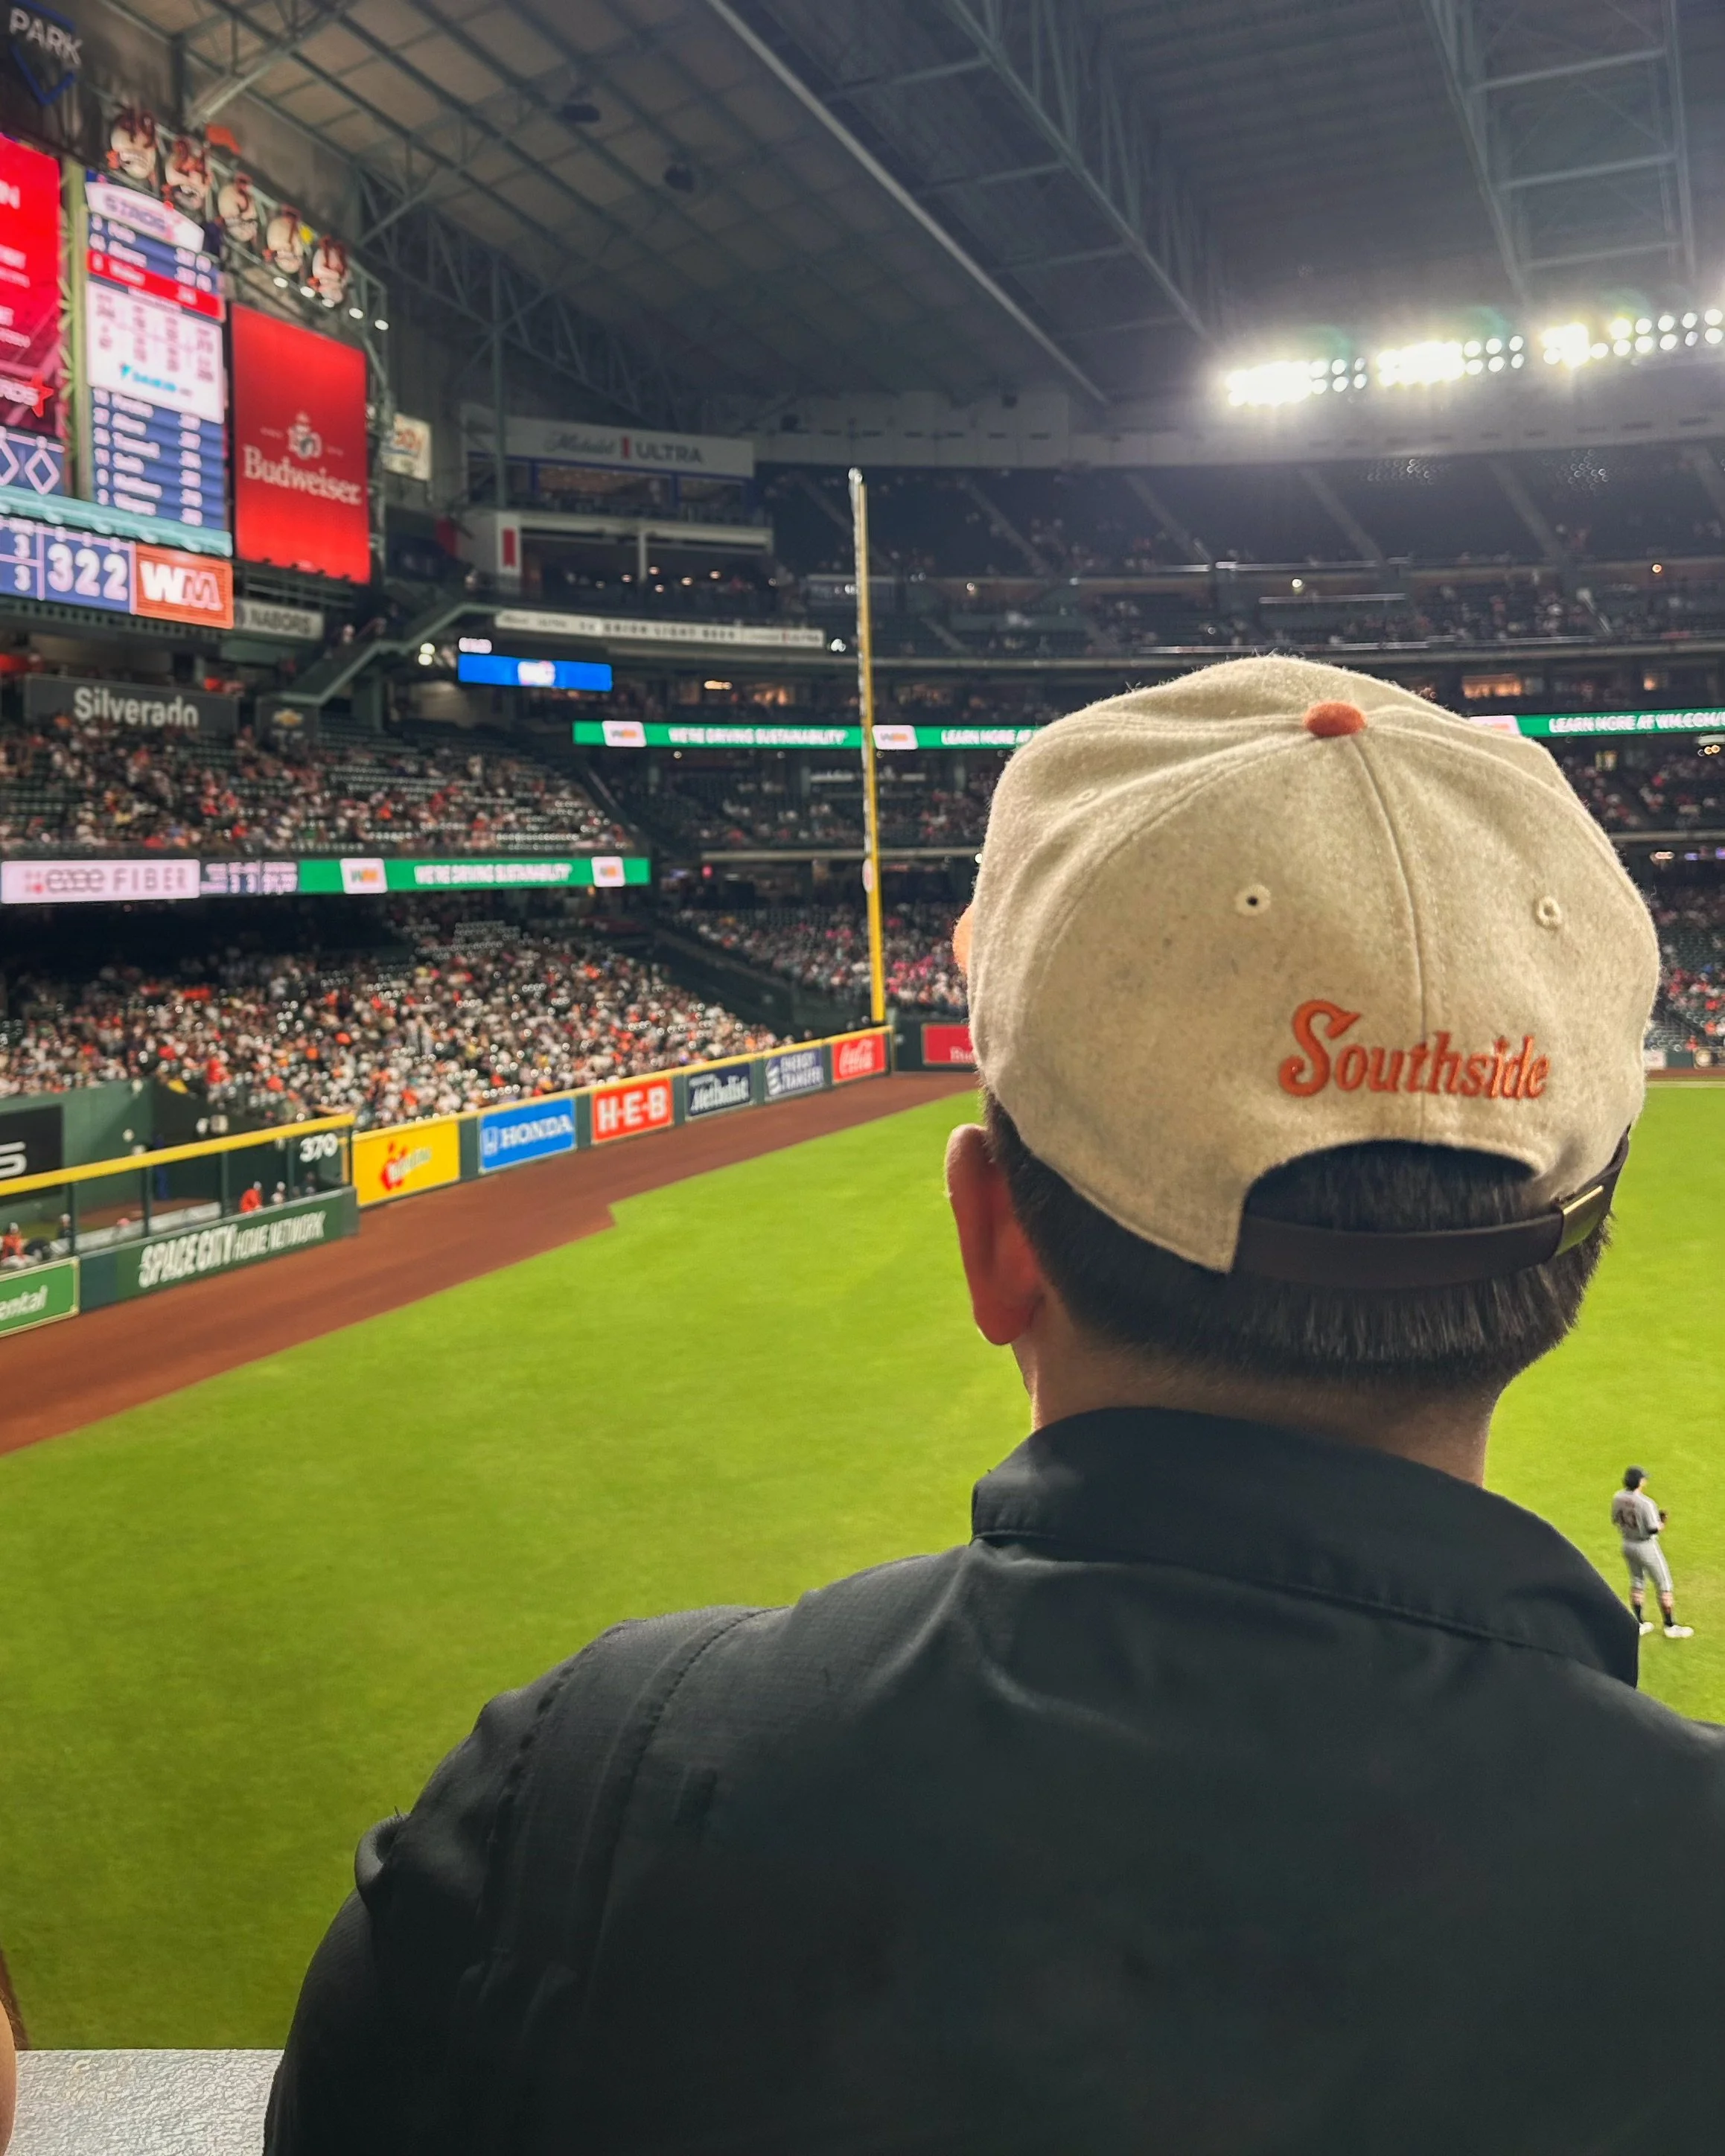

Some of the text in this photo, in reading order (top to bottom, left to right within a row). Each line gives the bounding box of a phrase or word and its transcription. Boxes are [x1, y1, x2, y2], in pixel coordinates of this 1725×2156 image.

[9, 7, 83, 65] PARK
[637, 442, 702, 462] ULTRA
[243, 444, 363, 505] Budweiser
[74, 686, 200, 728] Silverado
[940, 729, 980, 745] LEARN
[1549, 716, 1596, 733] LEARN
[1595, 715, 1638, 731] MORE
[1636, 714, 1657, 730] AT
[112, 867, 187, 893] FIBER
[781, 1050, 817, 1074] ENERGY
[1278, 999, 1551, 1099] Southside
[780, 1065, 824, 1091] TRANSFER
[500, 1114, 575, 1149] HONDA
[299, 1132, 339, 1163] 370
[138, 1210, 328, 1288] SPACE CITY HOME NETWORK
